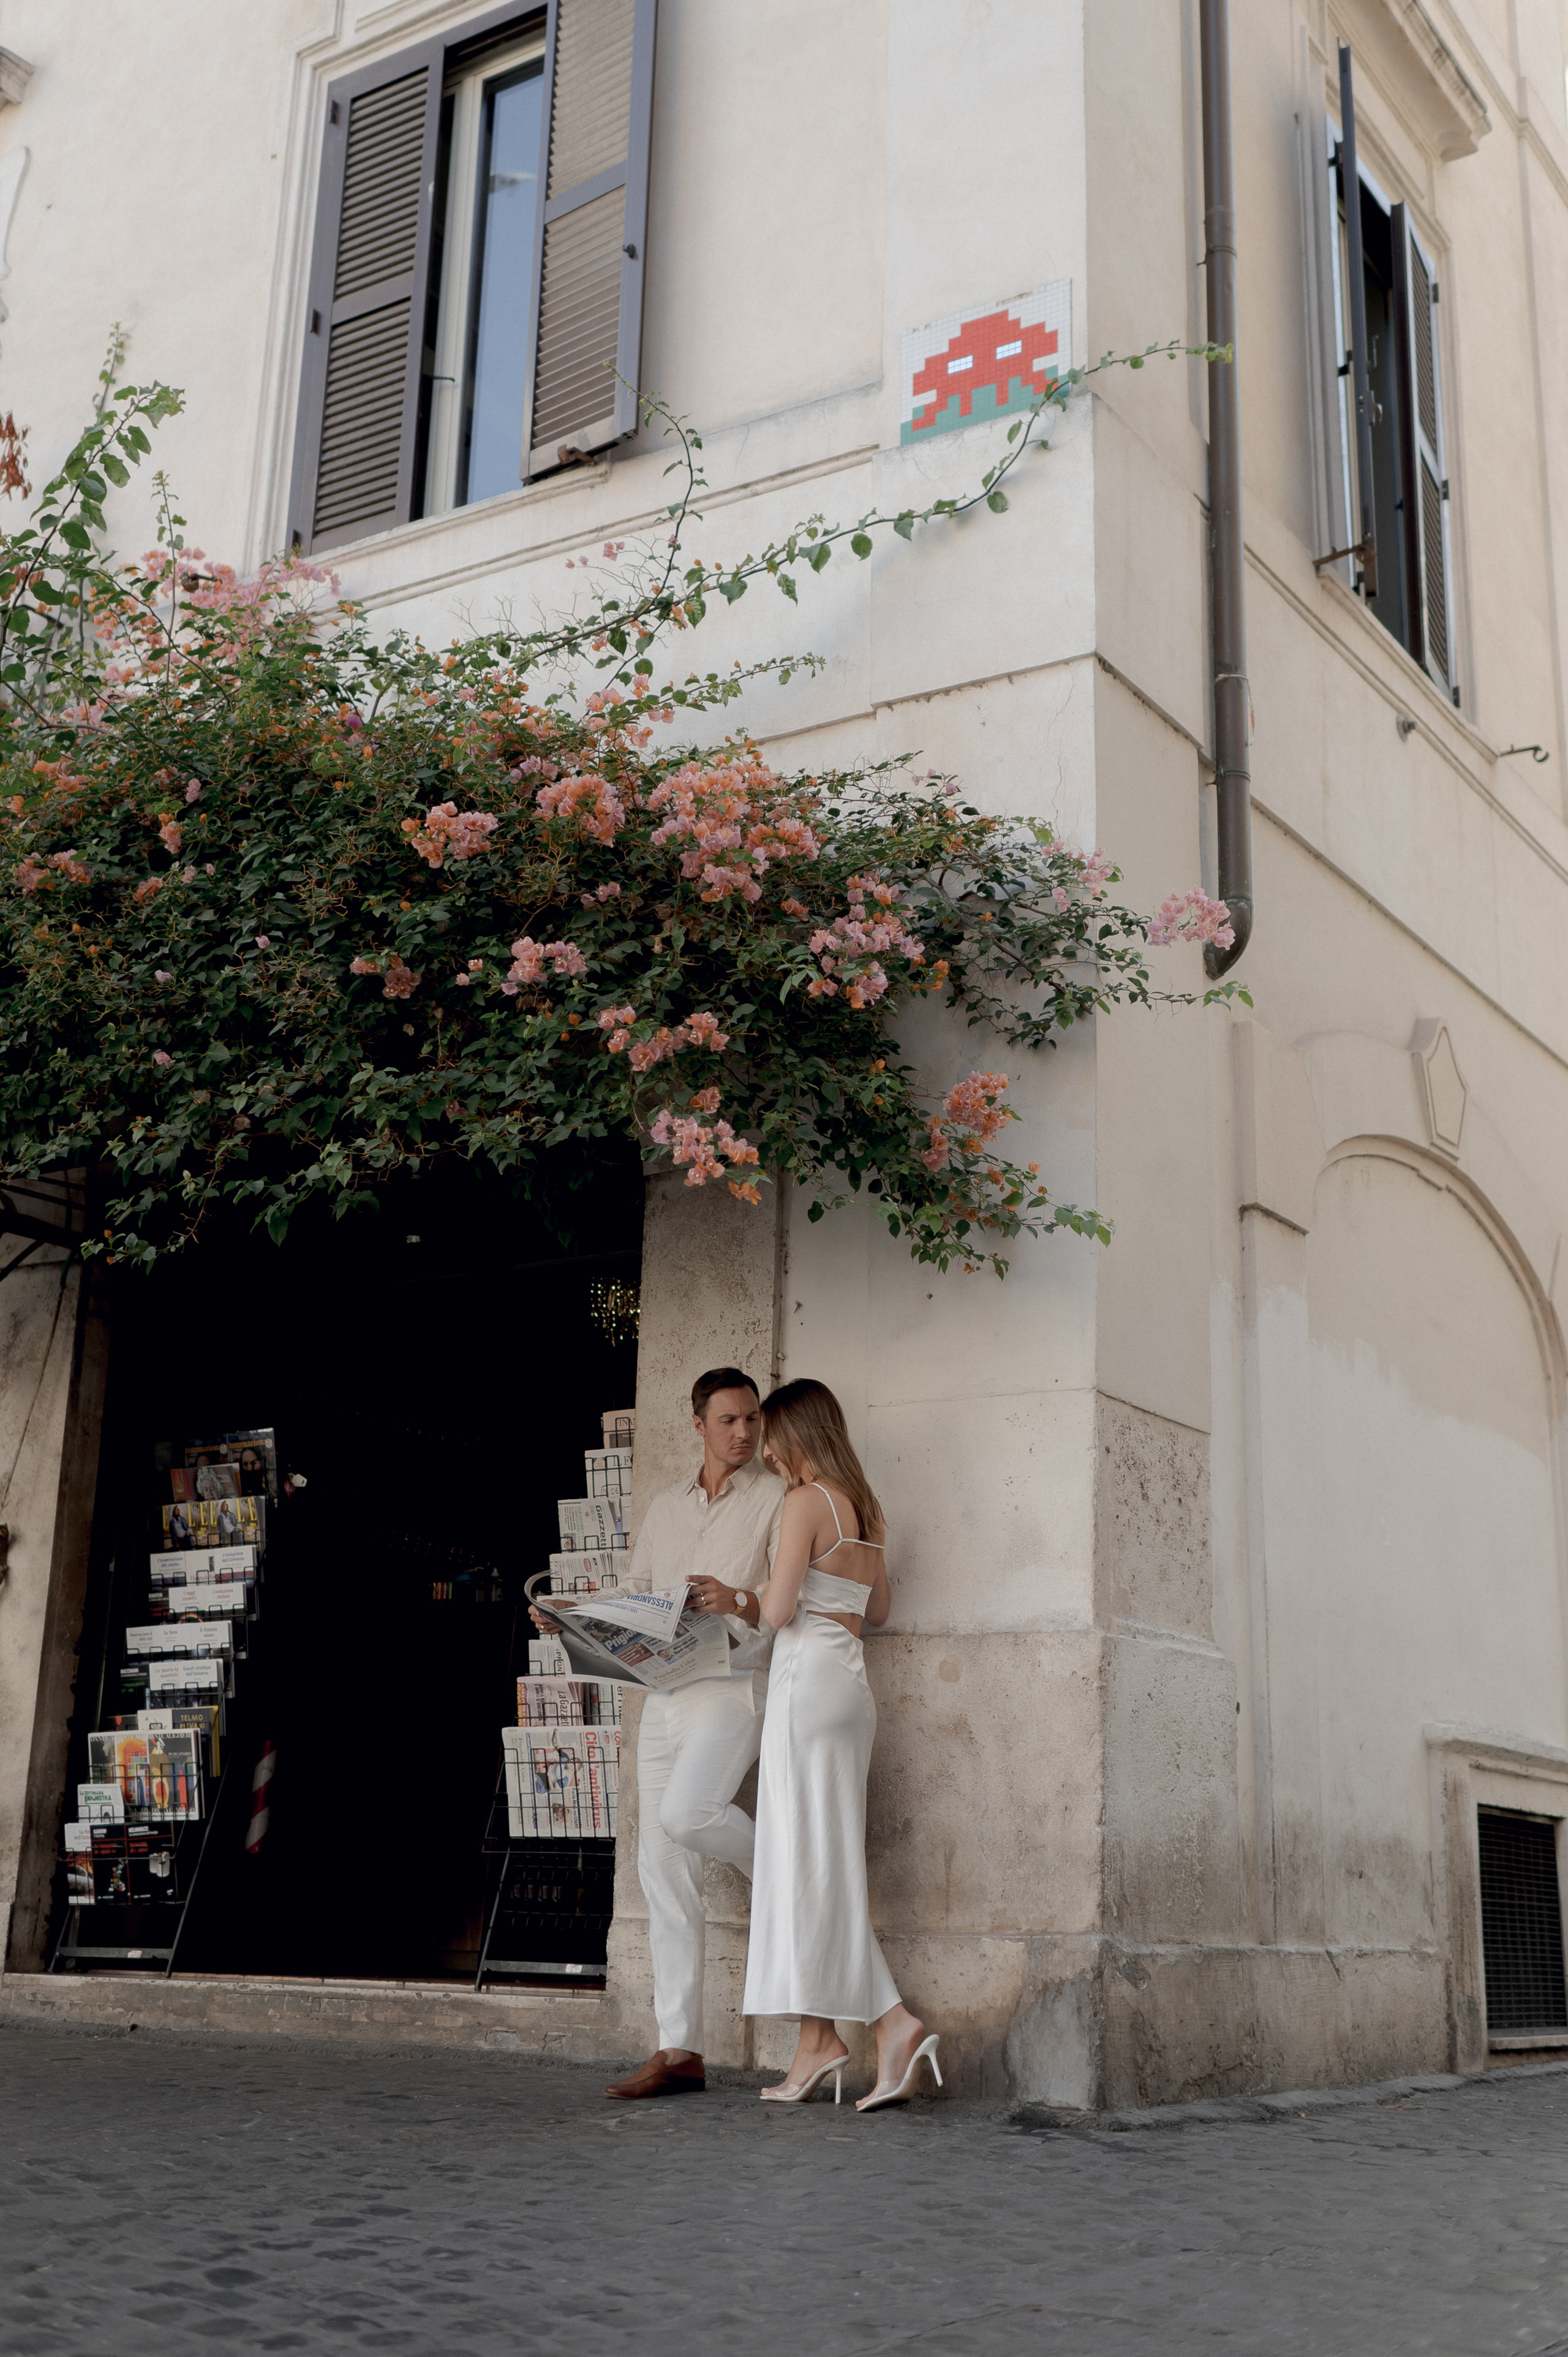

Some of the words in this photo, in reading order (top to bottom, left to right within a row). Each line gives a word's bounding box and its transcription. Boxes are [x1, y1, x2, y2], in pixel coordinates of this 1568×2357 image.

[612, 1456, 622, 1466] IL
[162, 1502, 209, 1531] ELE
[210, 1497, 257, 1526] ELE
[680, 1658, 696, 1668] Color
[585, 1732, 597, 1759] Ciro
[589, 1761, 602, 1829] l'antivirus
